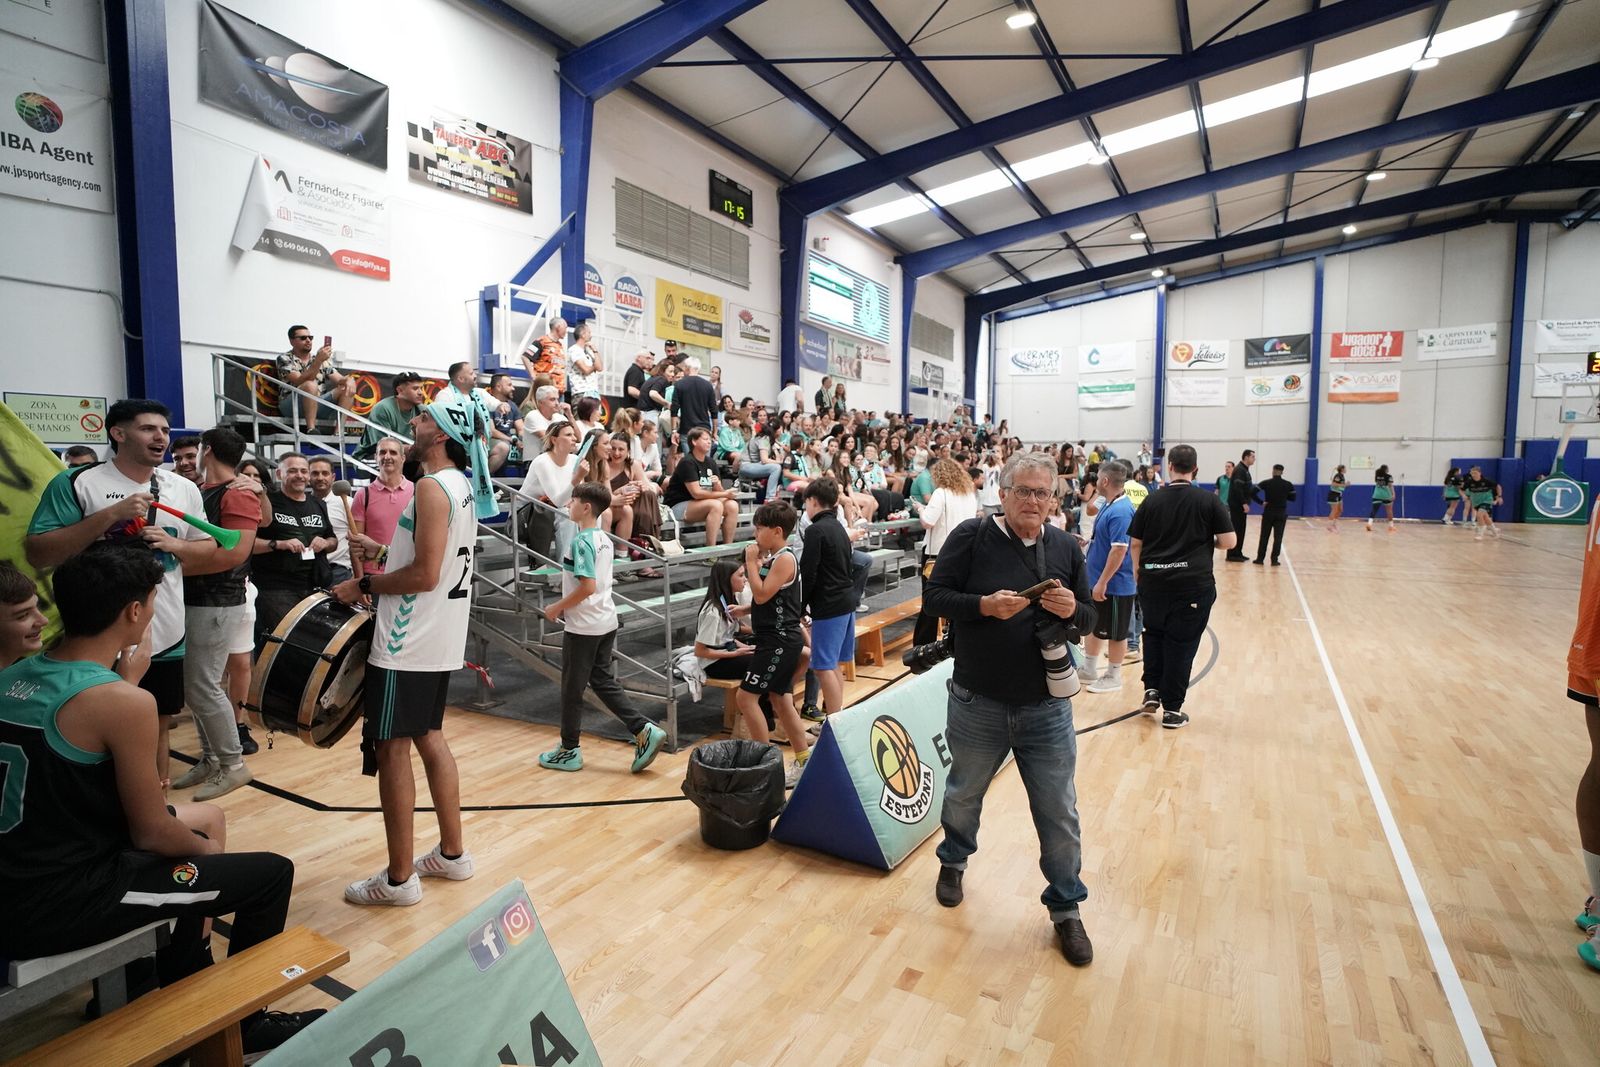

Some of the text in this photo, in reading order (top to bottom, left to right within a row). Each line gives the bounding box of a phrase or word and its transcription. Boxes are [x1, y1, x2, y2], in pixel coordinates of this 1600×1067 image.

[236, 83, 366, 146] AMACOSTA
[40, 142, 94, 165] Agent
[476, 142, 510, 165] ABC
[297, 186, 305, 196] &
[298, 176, 350, 200] Fernández
[617, 281, 639, 295] RADIO
[615, 291, 642, 310] MARCA
[30, 400, 57, 410] ZONA
[37, 424, 71, 433] MANOS
[745, 671, 760, 685] 15
[884, 770, 932, 819] ESTEPONA
